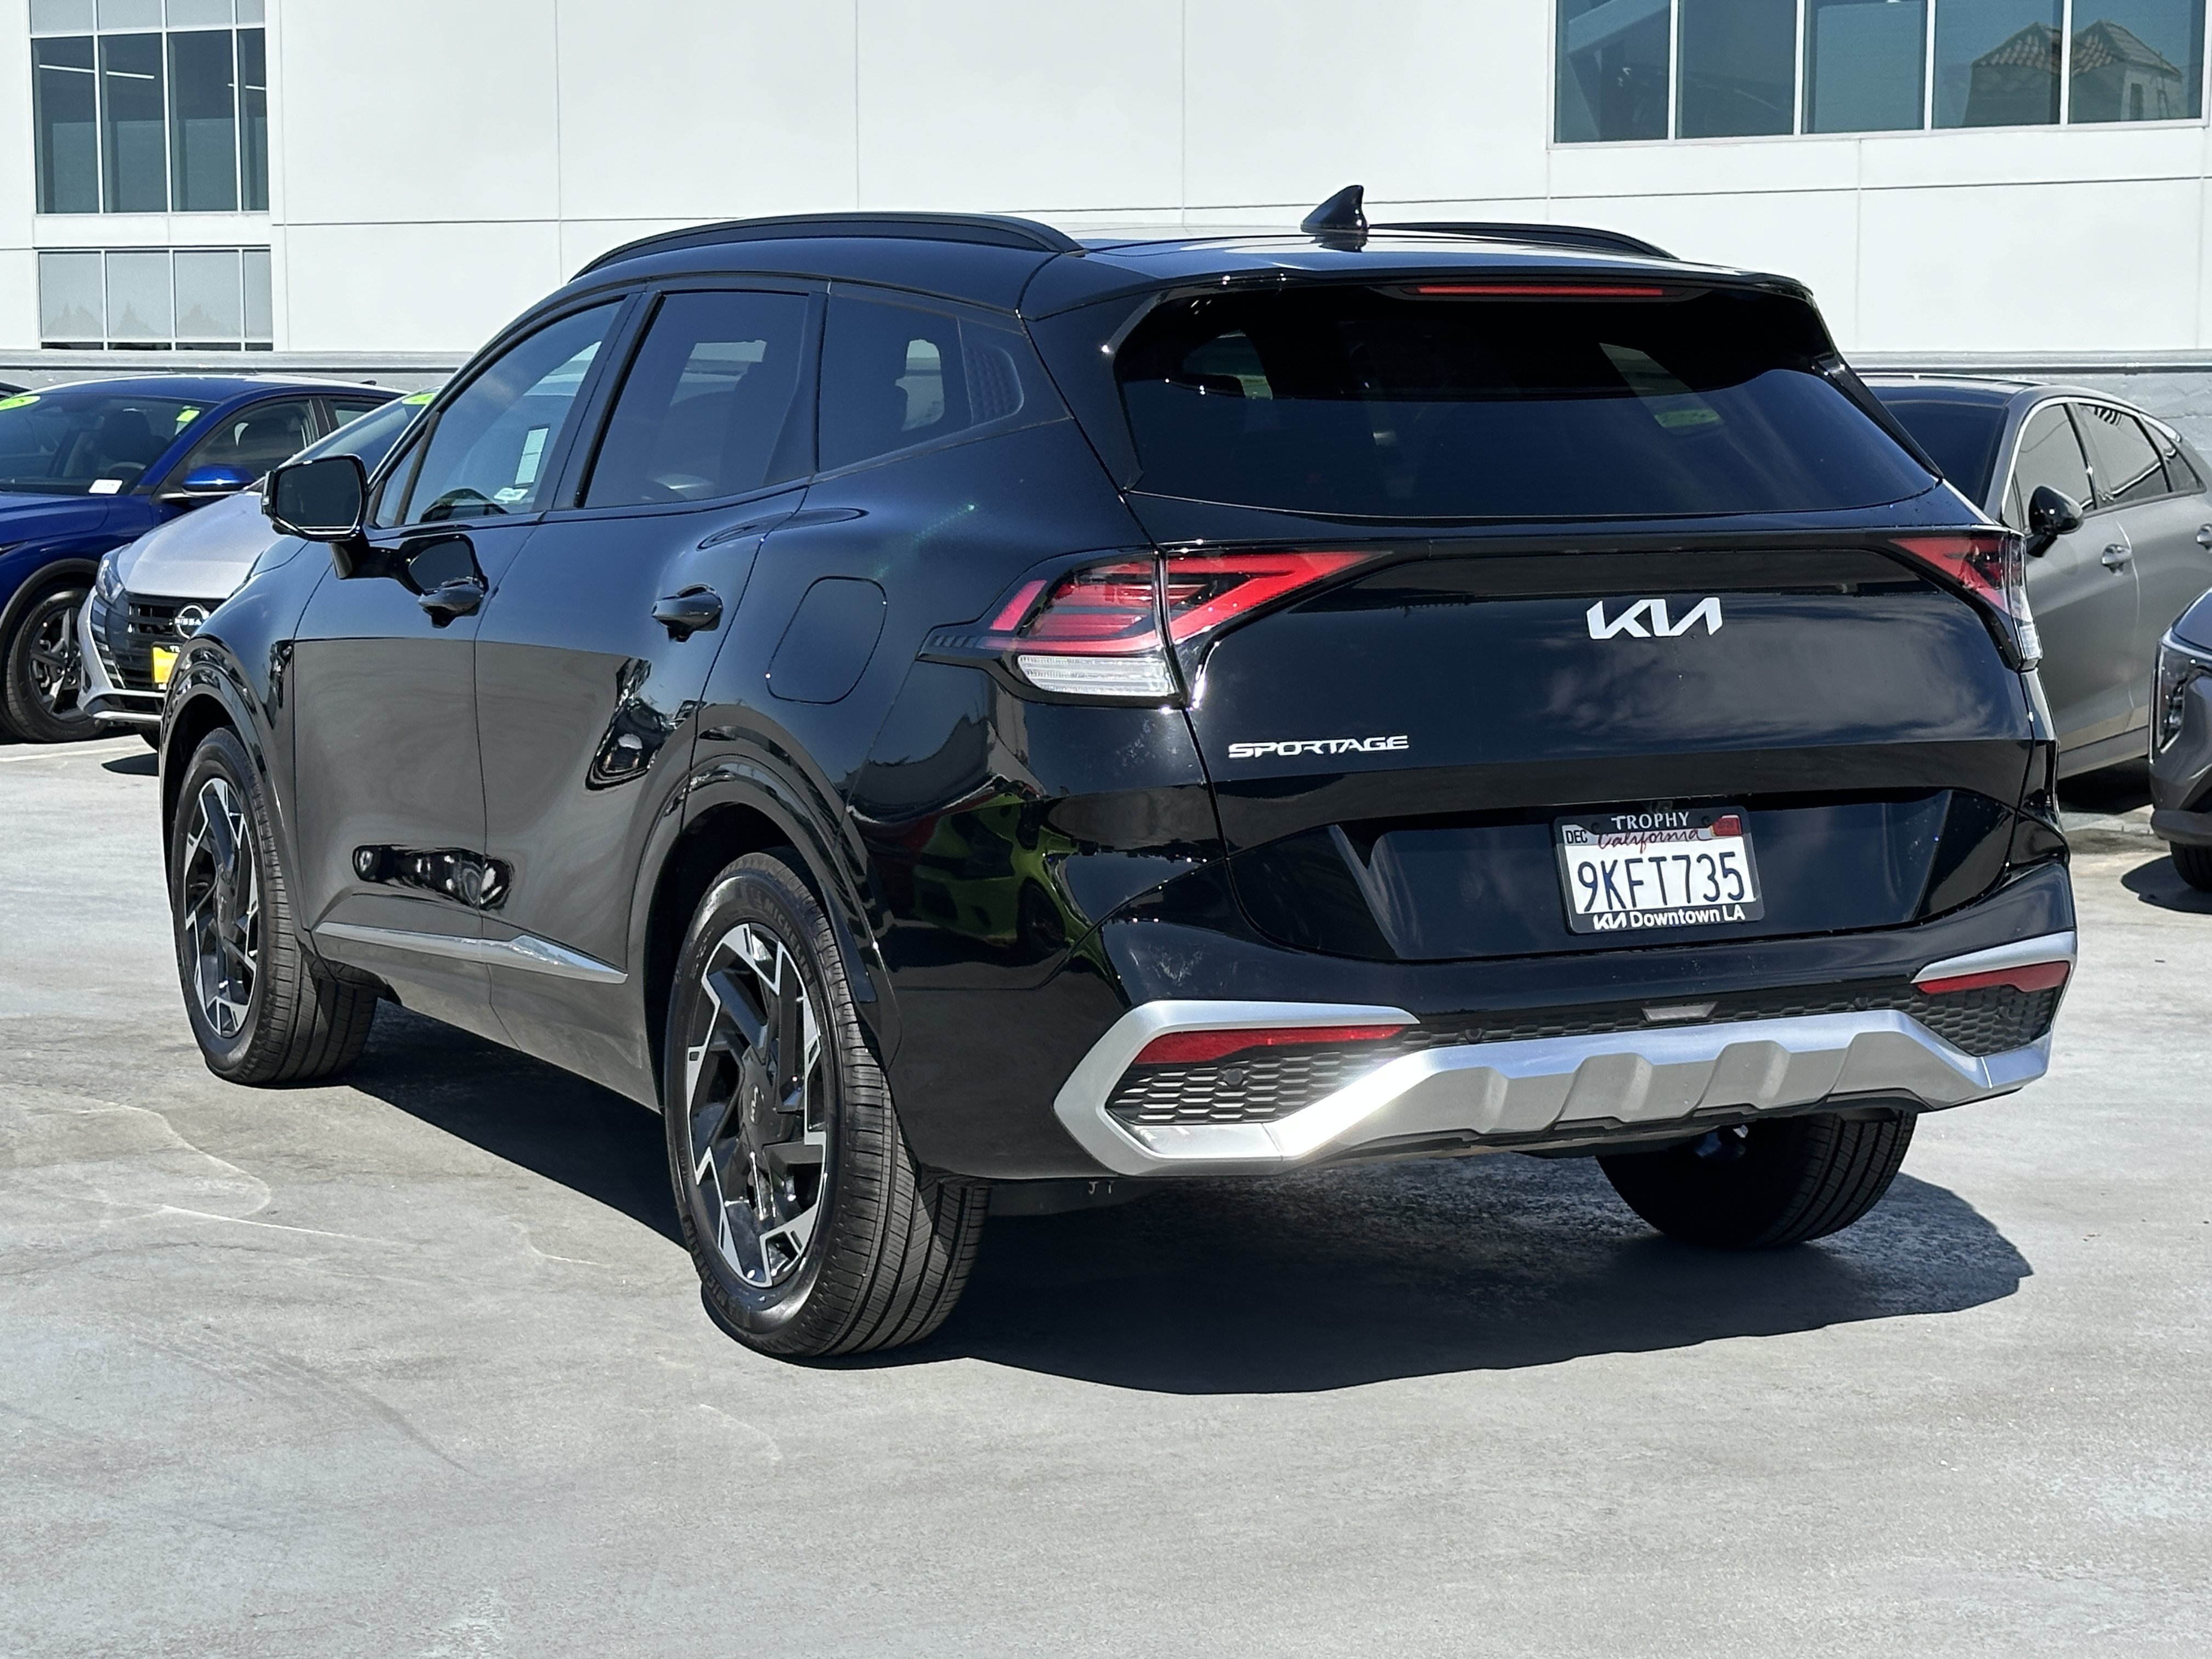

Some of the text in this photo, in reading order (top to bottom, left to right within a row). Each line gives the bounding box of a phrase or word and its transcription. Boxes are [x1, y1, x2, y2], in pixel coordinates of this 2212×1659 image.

[174, 618, 202, 626] NISSA
[1228, 735, 1409, 759] SPORTAGE
[1611, 811, 1690, 831] TROPHY
[1565, 829, 1588, 844] DEC
[1597, 828, 1711, 854] California
[1577, 851, 1745, 912] 9KFT735
[1629, 908, 1720, 928] Downtown
[1722, 905, 1746, 922] LA
[764, 897, 812, 981] MICHELIN
